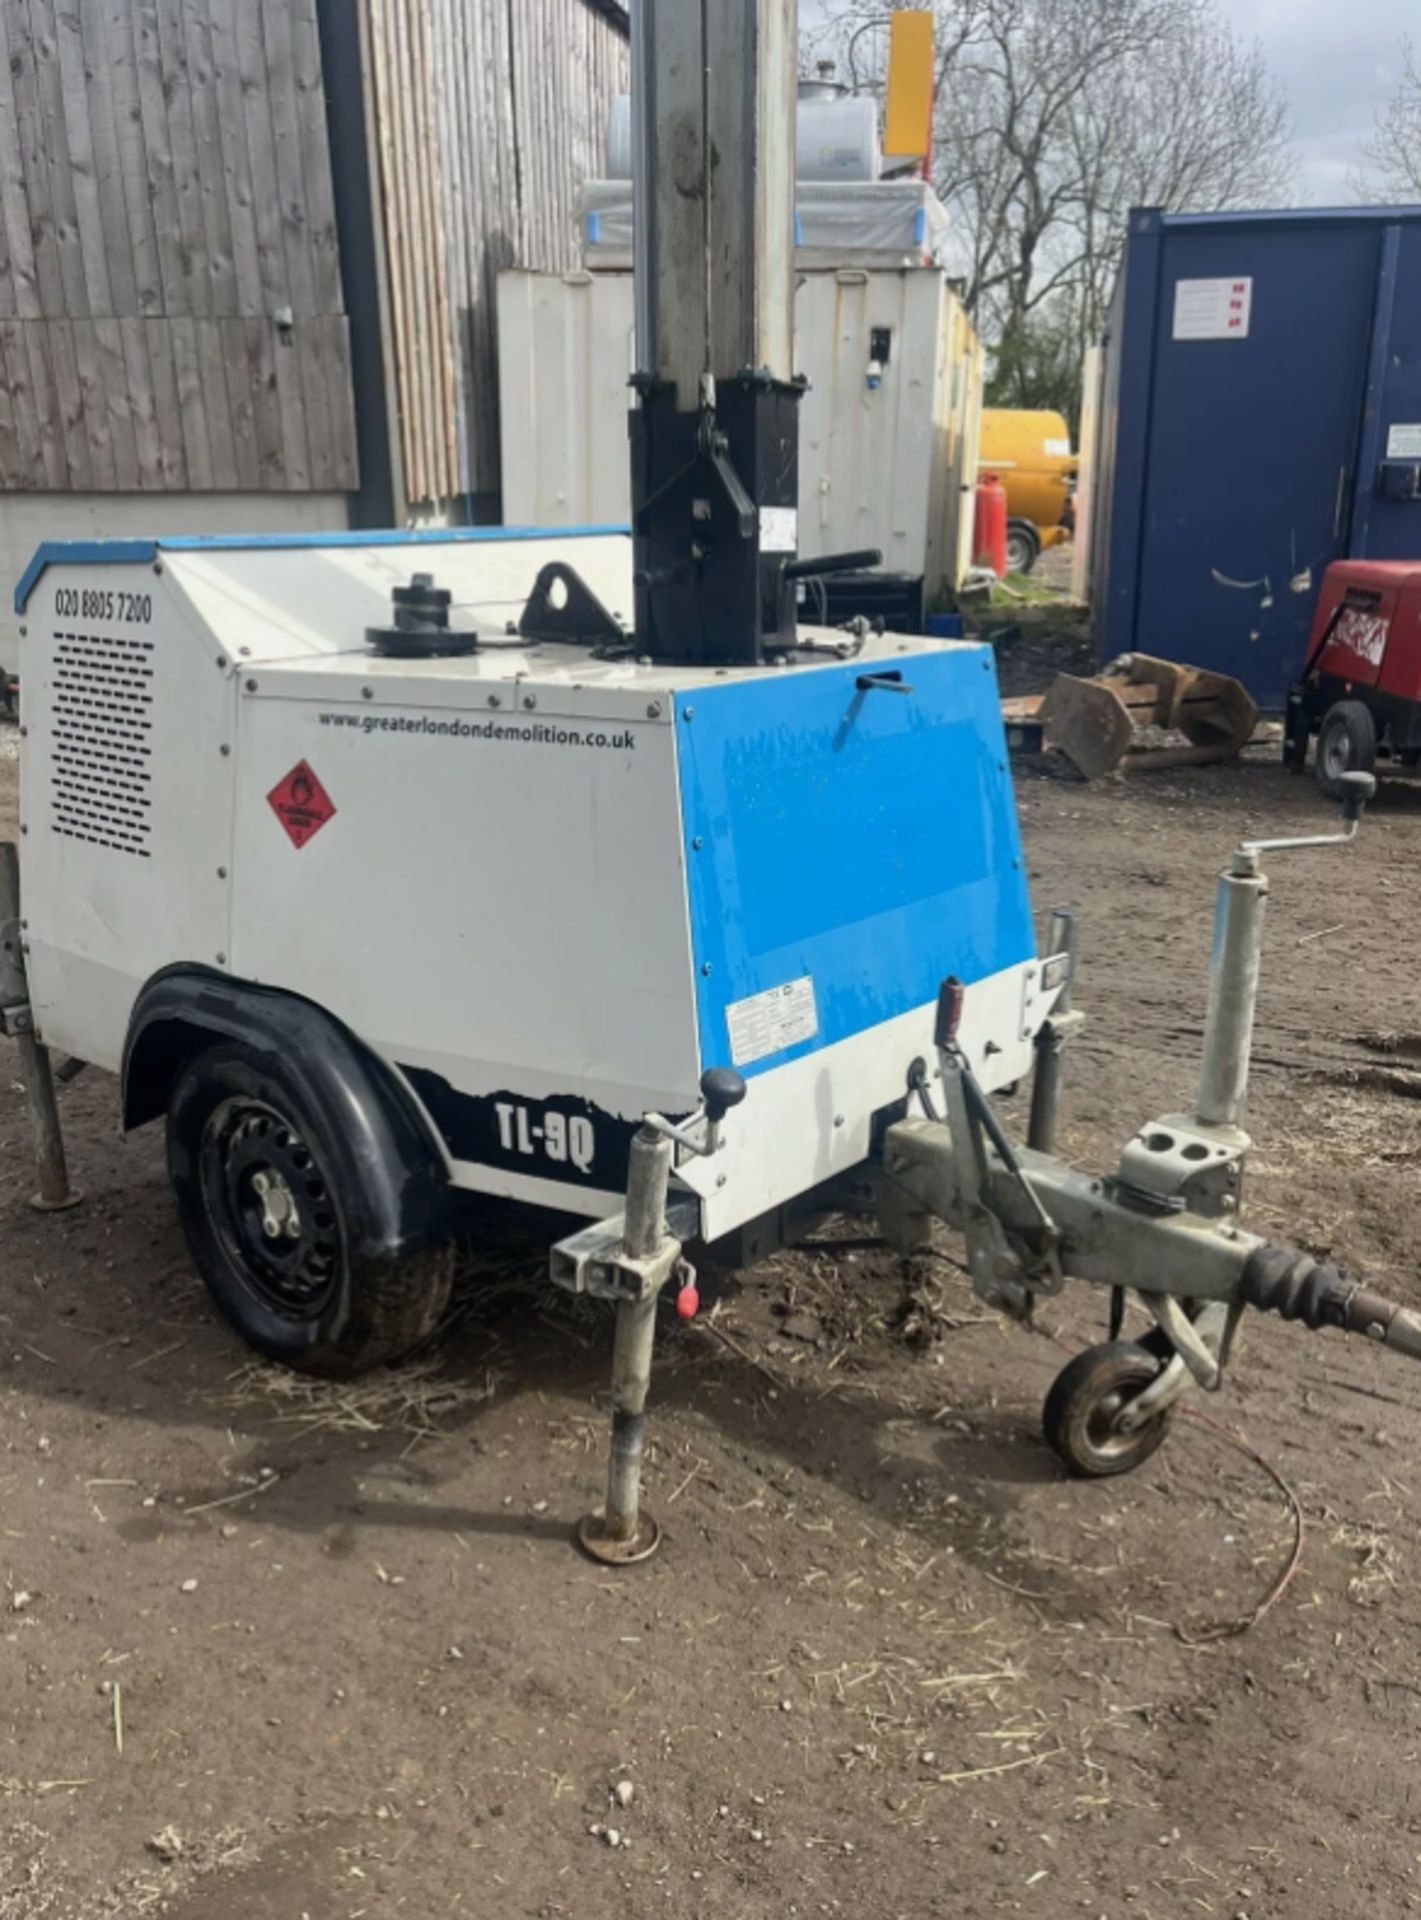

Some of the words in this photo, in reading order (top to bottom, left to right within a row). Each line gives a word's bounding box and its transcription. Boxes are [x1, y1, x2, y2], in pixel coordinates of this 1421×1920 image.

[55, 588, 79, 617] 020
[82, 589, 114, 620] 8805
[118, 593, 152, 624] 7200
[318, 711, 636, 749] www.greaterlondondemolition.co.uk
